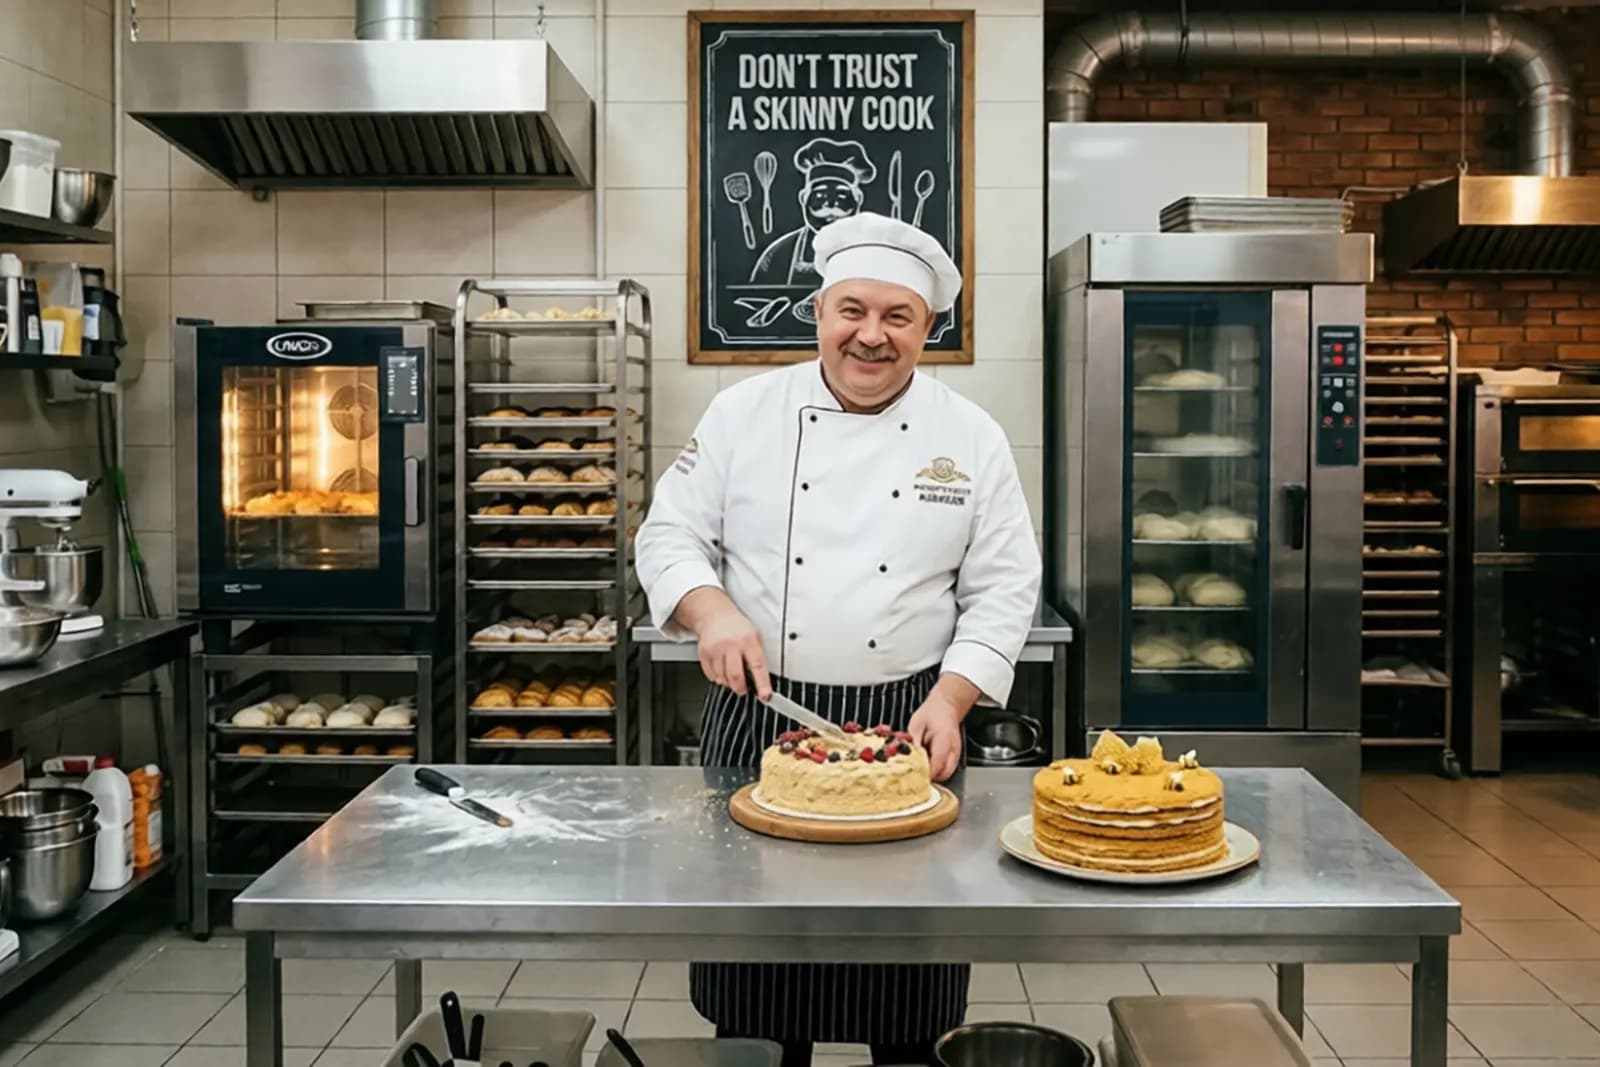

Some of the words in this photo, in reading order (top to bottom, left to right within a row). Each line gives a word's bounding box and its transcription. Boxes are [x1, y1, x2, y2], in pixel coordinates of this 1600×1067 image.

[739, 54, 821, 89] DON'T
[828, 54, 918, 89] TRUST
[728, 96, 747, 131] A
[753, 96, 855, 131] SKINNY
[862, 95, 935, 131] COOK
